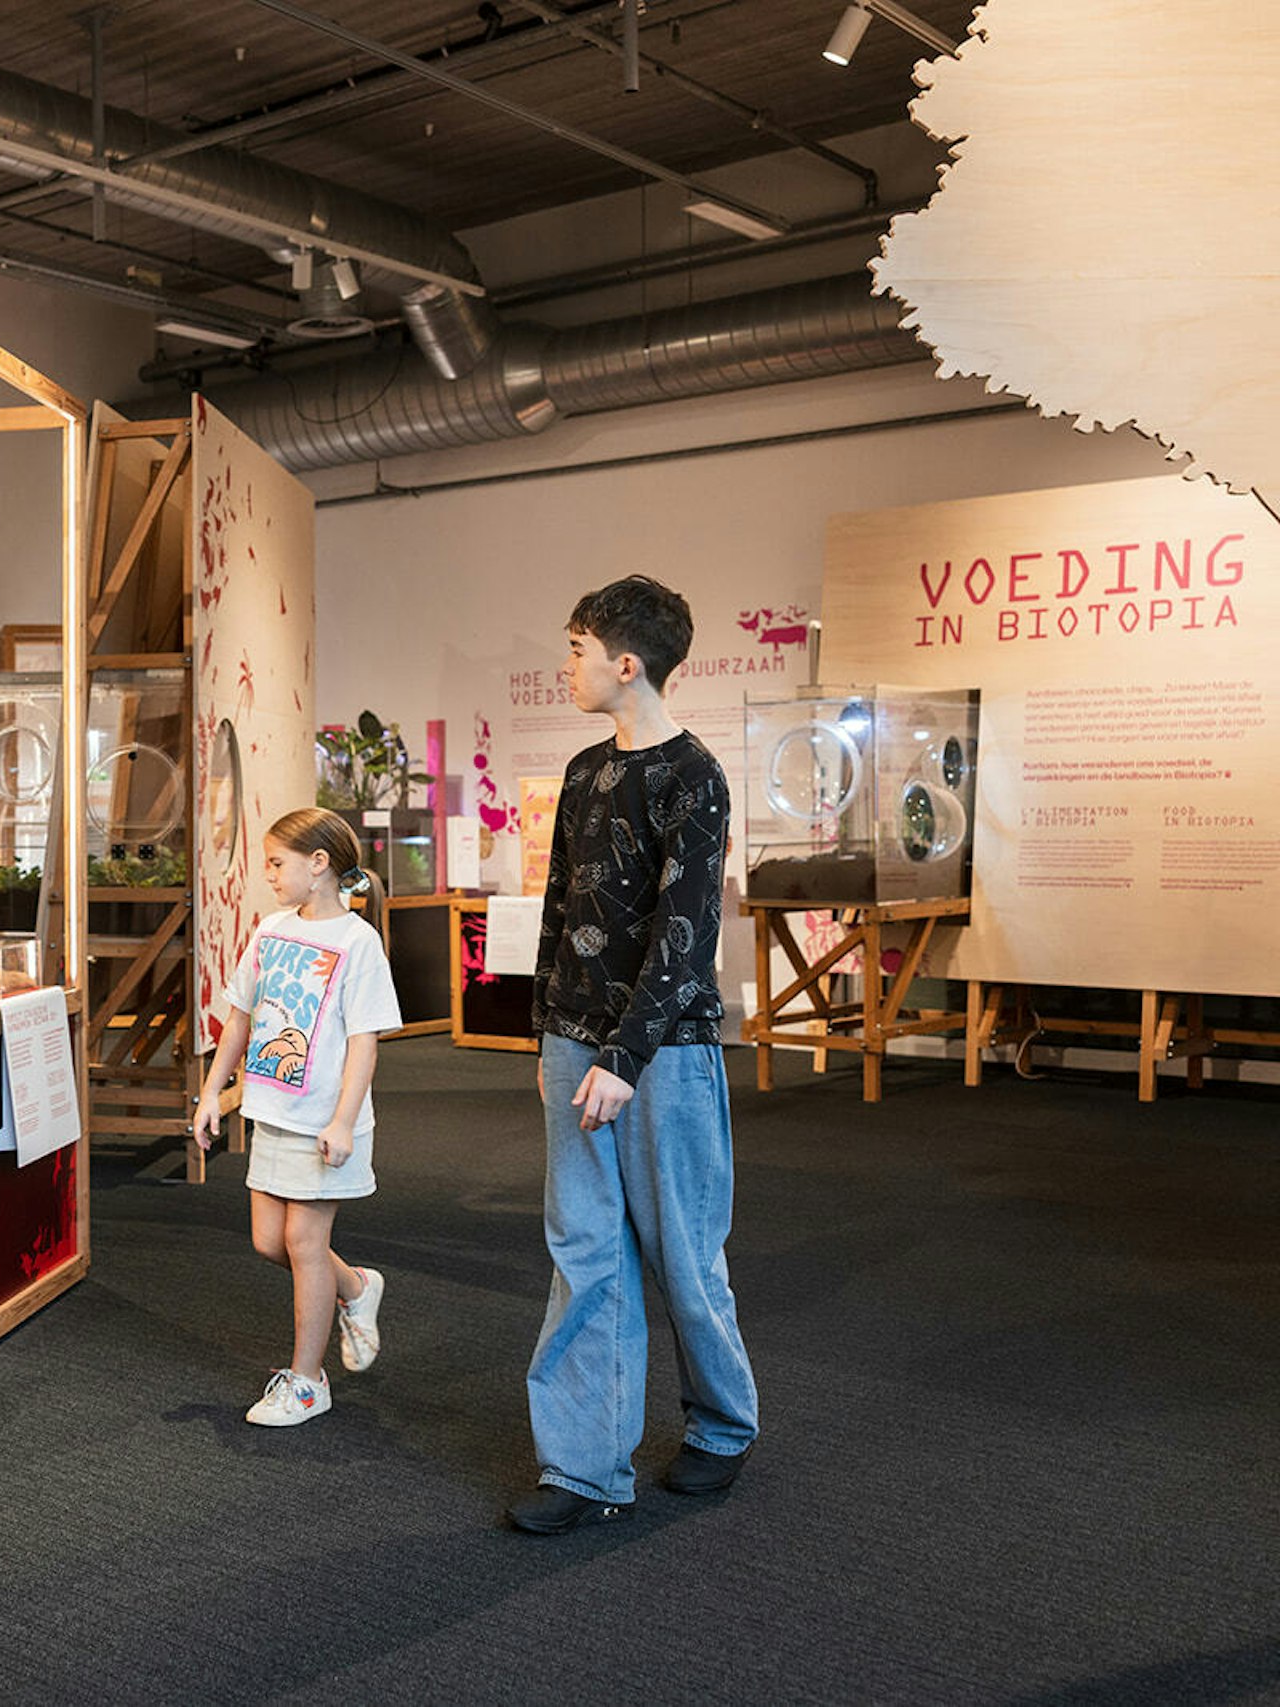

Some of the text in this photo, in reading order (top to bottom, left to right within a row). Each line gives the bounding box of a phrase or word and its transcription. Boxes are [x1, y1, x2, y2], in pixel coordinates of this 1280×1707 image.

[920, 534, 1245, 608] VOEDING
[914, 595, 1238, 647] IN BIOTOPIA
[510, 671, 542, 687] HOE
[680, 655, 785, 679] DUURZAAM
